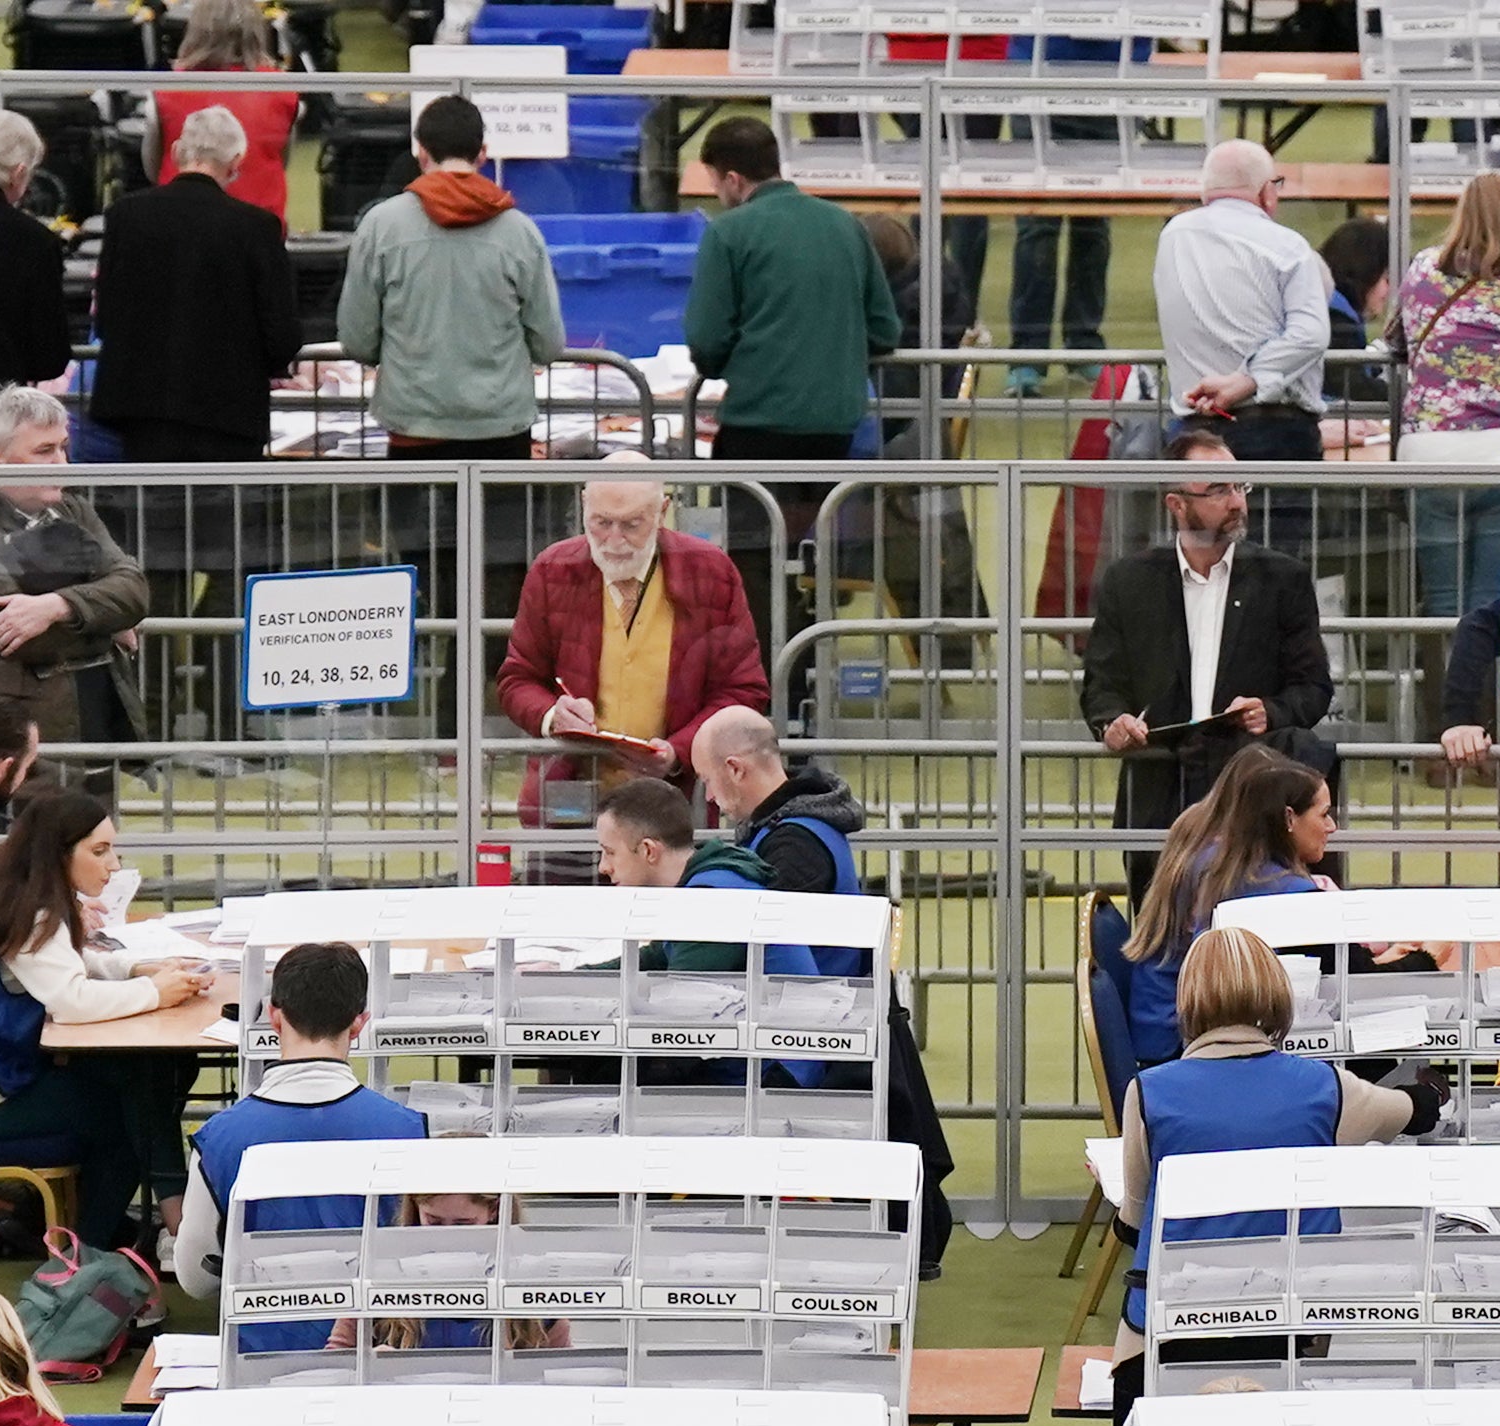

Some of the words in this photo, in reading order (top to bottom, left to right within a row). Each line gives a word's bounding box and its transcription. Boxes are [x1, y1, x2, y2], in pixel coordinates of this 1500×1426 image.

[259, 613, 294, 626] EAST
[299, 607, 405, 624] LONDONDERRY
[260, 633, 335, 646] VERIFICATION
[338, 632, 352, 641] OF
[356, 629, 393, 640] BOXES
[262, 671, 285, 688] 10,
[291, 670, 314, 685] 24,
[321, 668, 343, 684] 38,
[350, 666, 373, 681] 52,
[380, 664, 398, 678] 66
[378, 1031, 487, 1046] ARMSTRONG
[524, 1030, 600, 1041] BRADLEY
[652, 1033, 715, 1044] BROLLY
[772, 1035, 851, 1051] COULSON
[243, 1293, 345, 1311] ARCHIBALD
[372, 1294, 484, 1305] ARMSTRONG
[523, 1292, 605, 1303] BRADLEY
[668, 1293, 736, 1304] BROLLY
[789, 1298, 877, 1314] COULSON
[1175, 1310, 1276, 1325] ARCHIBALD
[1306, 1308, 1419, 1319] ARMSTRONG
